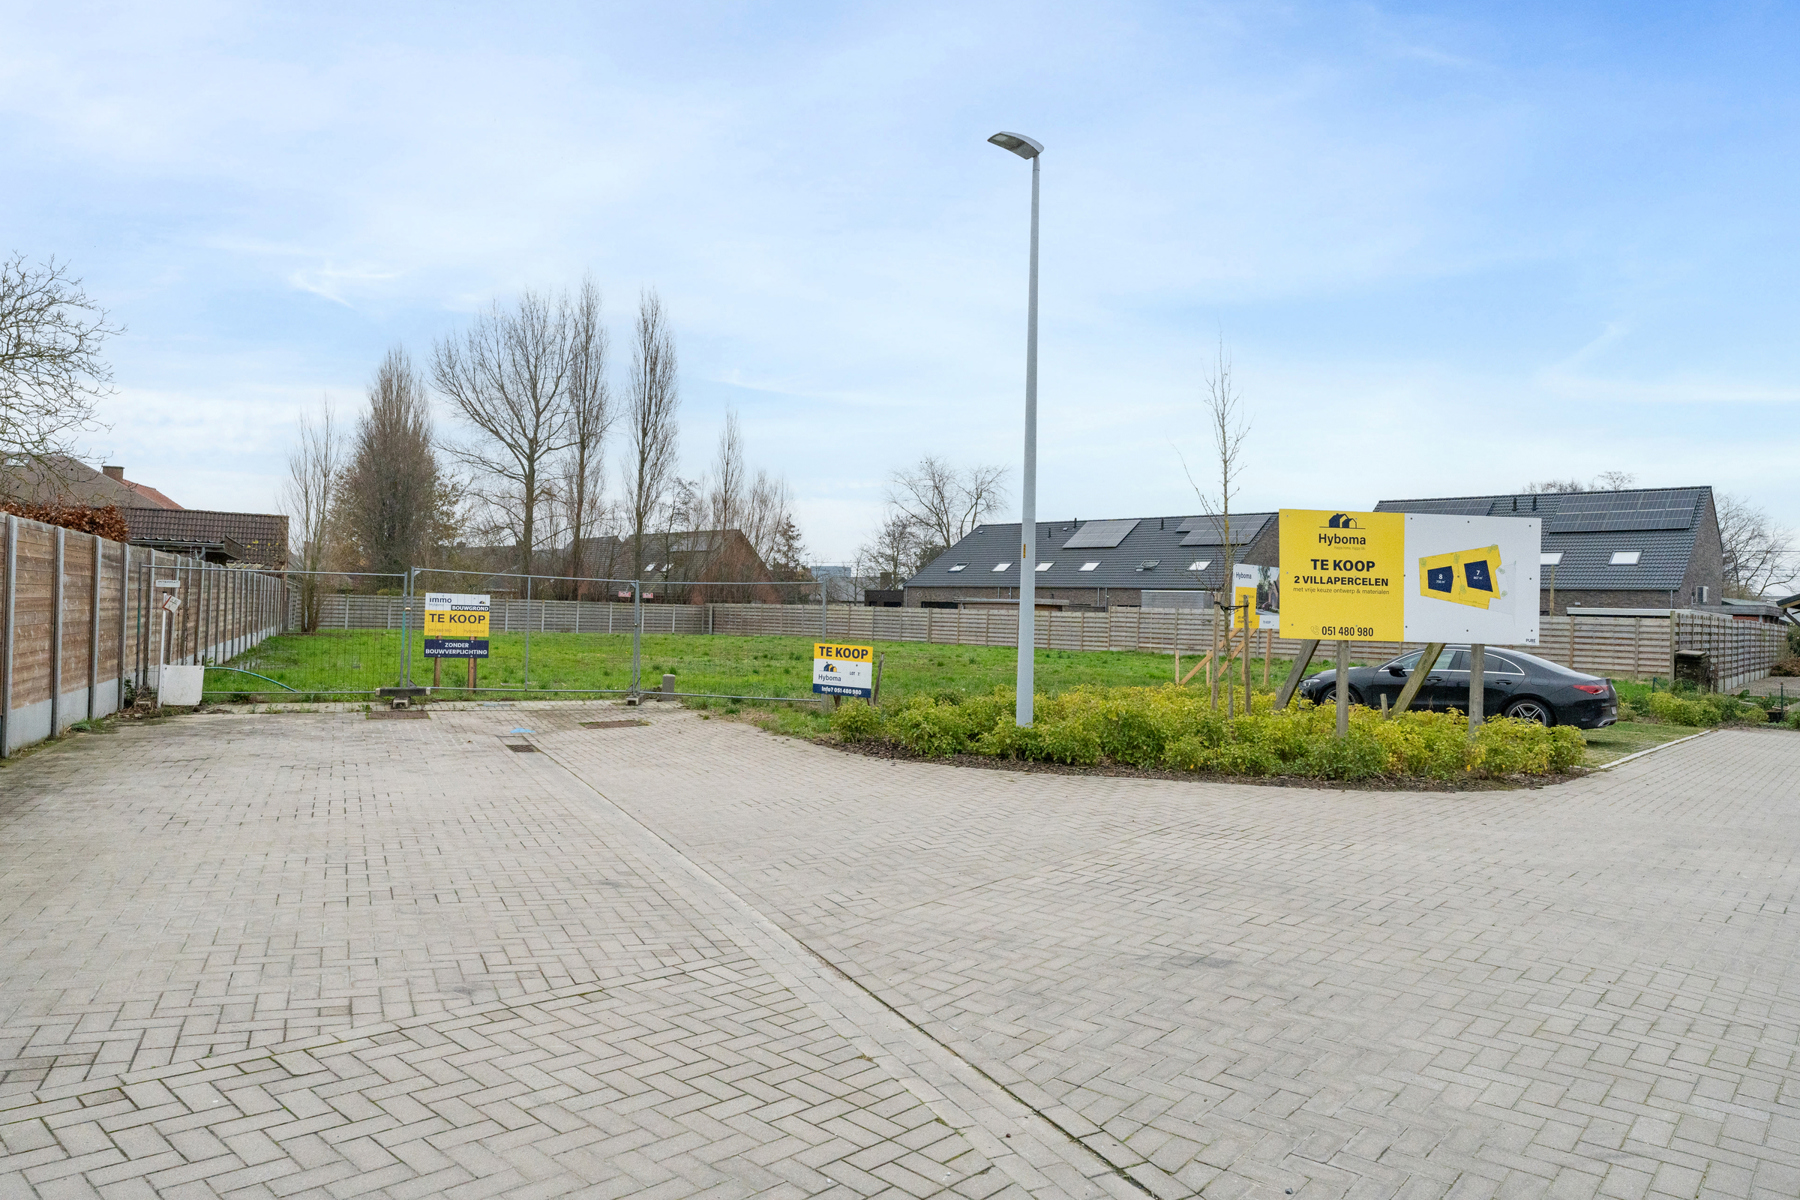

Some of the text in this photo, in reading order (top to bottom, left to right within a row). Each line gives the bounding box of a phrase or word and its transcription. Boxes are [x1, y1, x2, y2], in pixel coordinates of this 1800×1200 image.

[1318, 533, 1366, 546] Hyboma
[1310, 558, 1376, 572] TE KOOP
[1235, 572, 1252, 580] Hyboma
[1293, 575, 1389, 587] 2 VILLAPERCELEN
[429, 596, 452, 604] immo
[429, 613, 486, 624] TE KOOP
[1321, 625, 1374, 637] 051 480 980
[819, 645, 868, 659] TE KOOP
[818, 674, 841, 682] Hyboma
